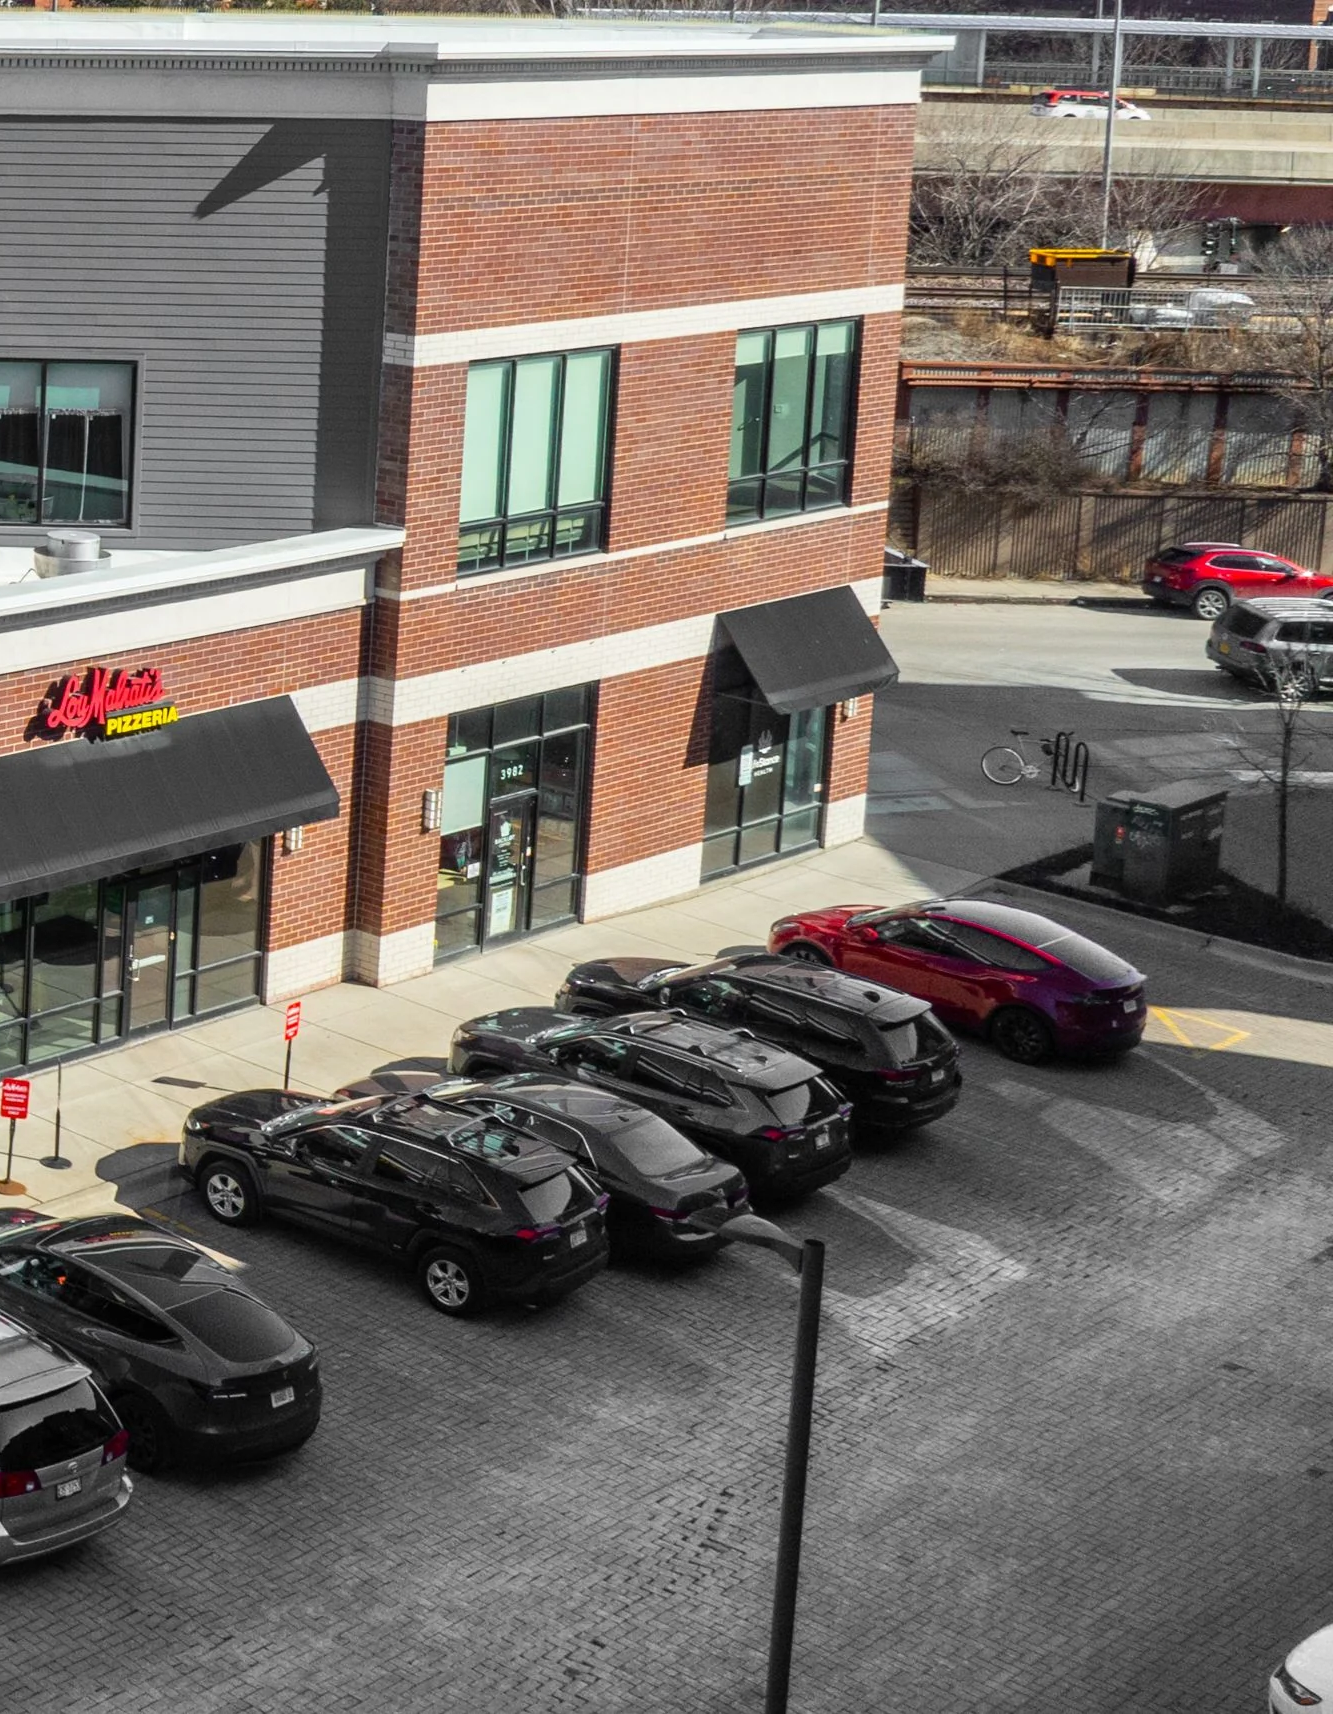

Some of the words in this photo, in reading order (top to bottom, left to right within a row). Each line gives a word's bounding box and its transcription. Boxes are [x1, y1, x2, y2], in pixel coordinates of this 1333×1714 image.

[47, 675, 92, 727] Lou
[85, 668, 165, 725] Malnati's
[106, 706, 179, 736] PIZZERIA
[500, 764, 524, 780] 3982
